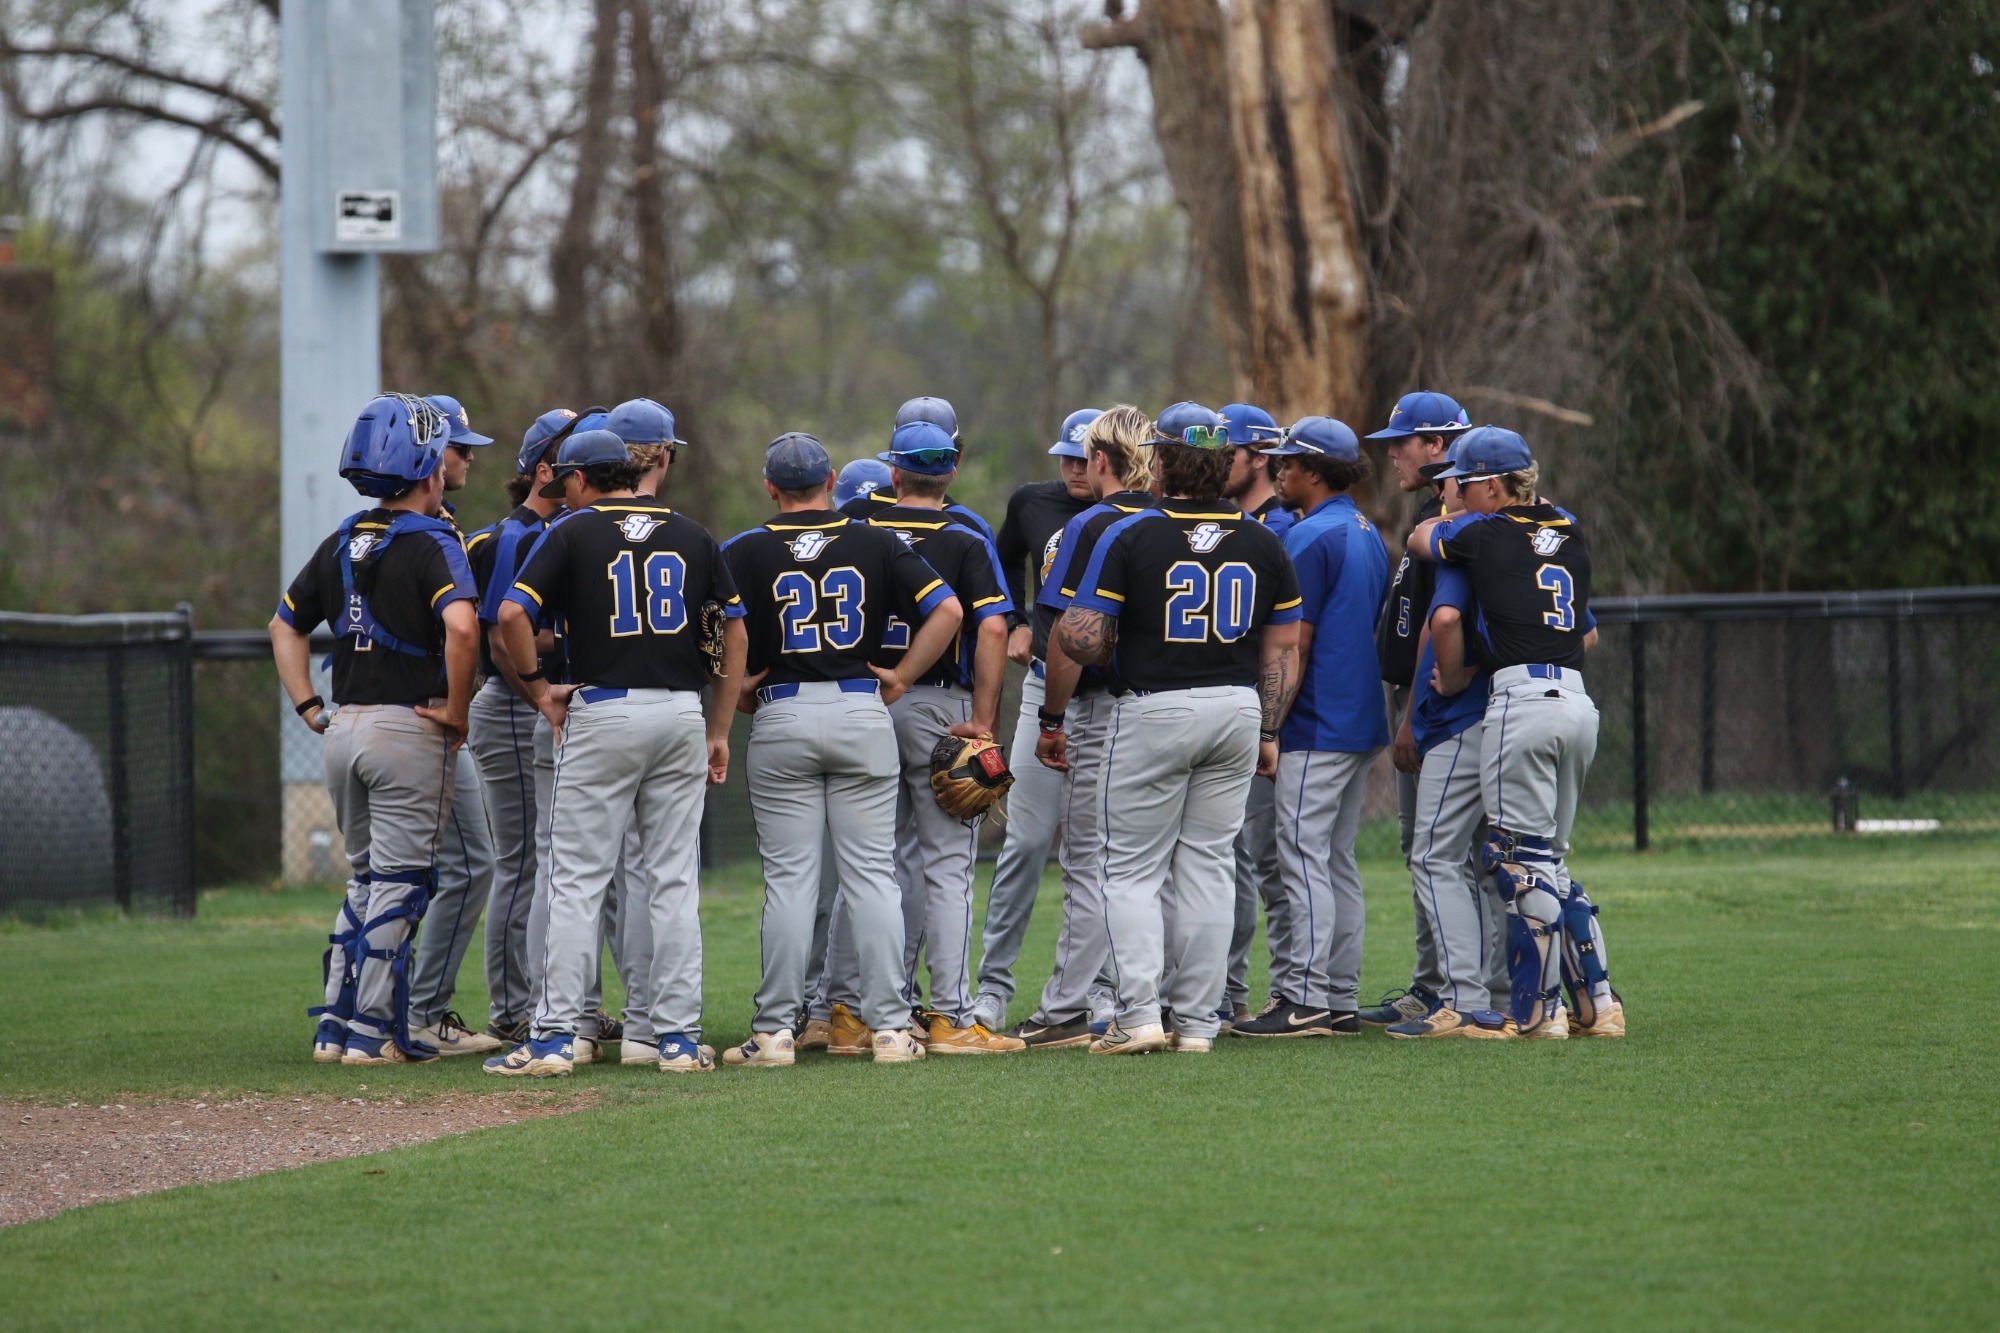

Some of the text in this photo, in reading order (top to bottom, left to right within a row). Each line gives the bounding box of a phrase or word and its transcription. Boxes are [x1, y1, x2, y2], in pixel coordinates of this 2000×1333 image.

[619, 513, 660, 542] SU
[788, 530, 829, 562] SU
[1187, 522, 1228, 553] SU
[1530, 526, 1567, 556] SU
[607, 550, 688, 637] 18
[772, 566, 865, 654] 23
[1165, 561, 1256, 643] 20
[1536, 563, 1574, 632] 3
[1397, 596, 1410, 637] 5
